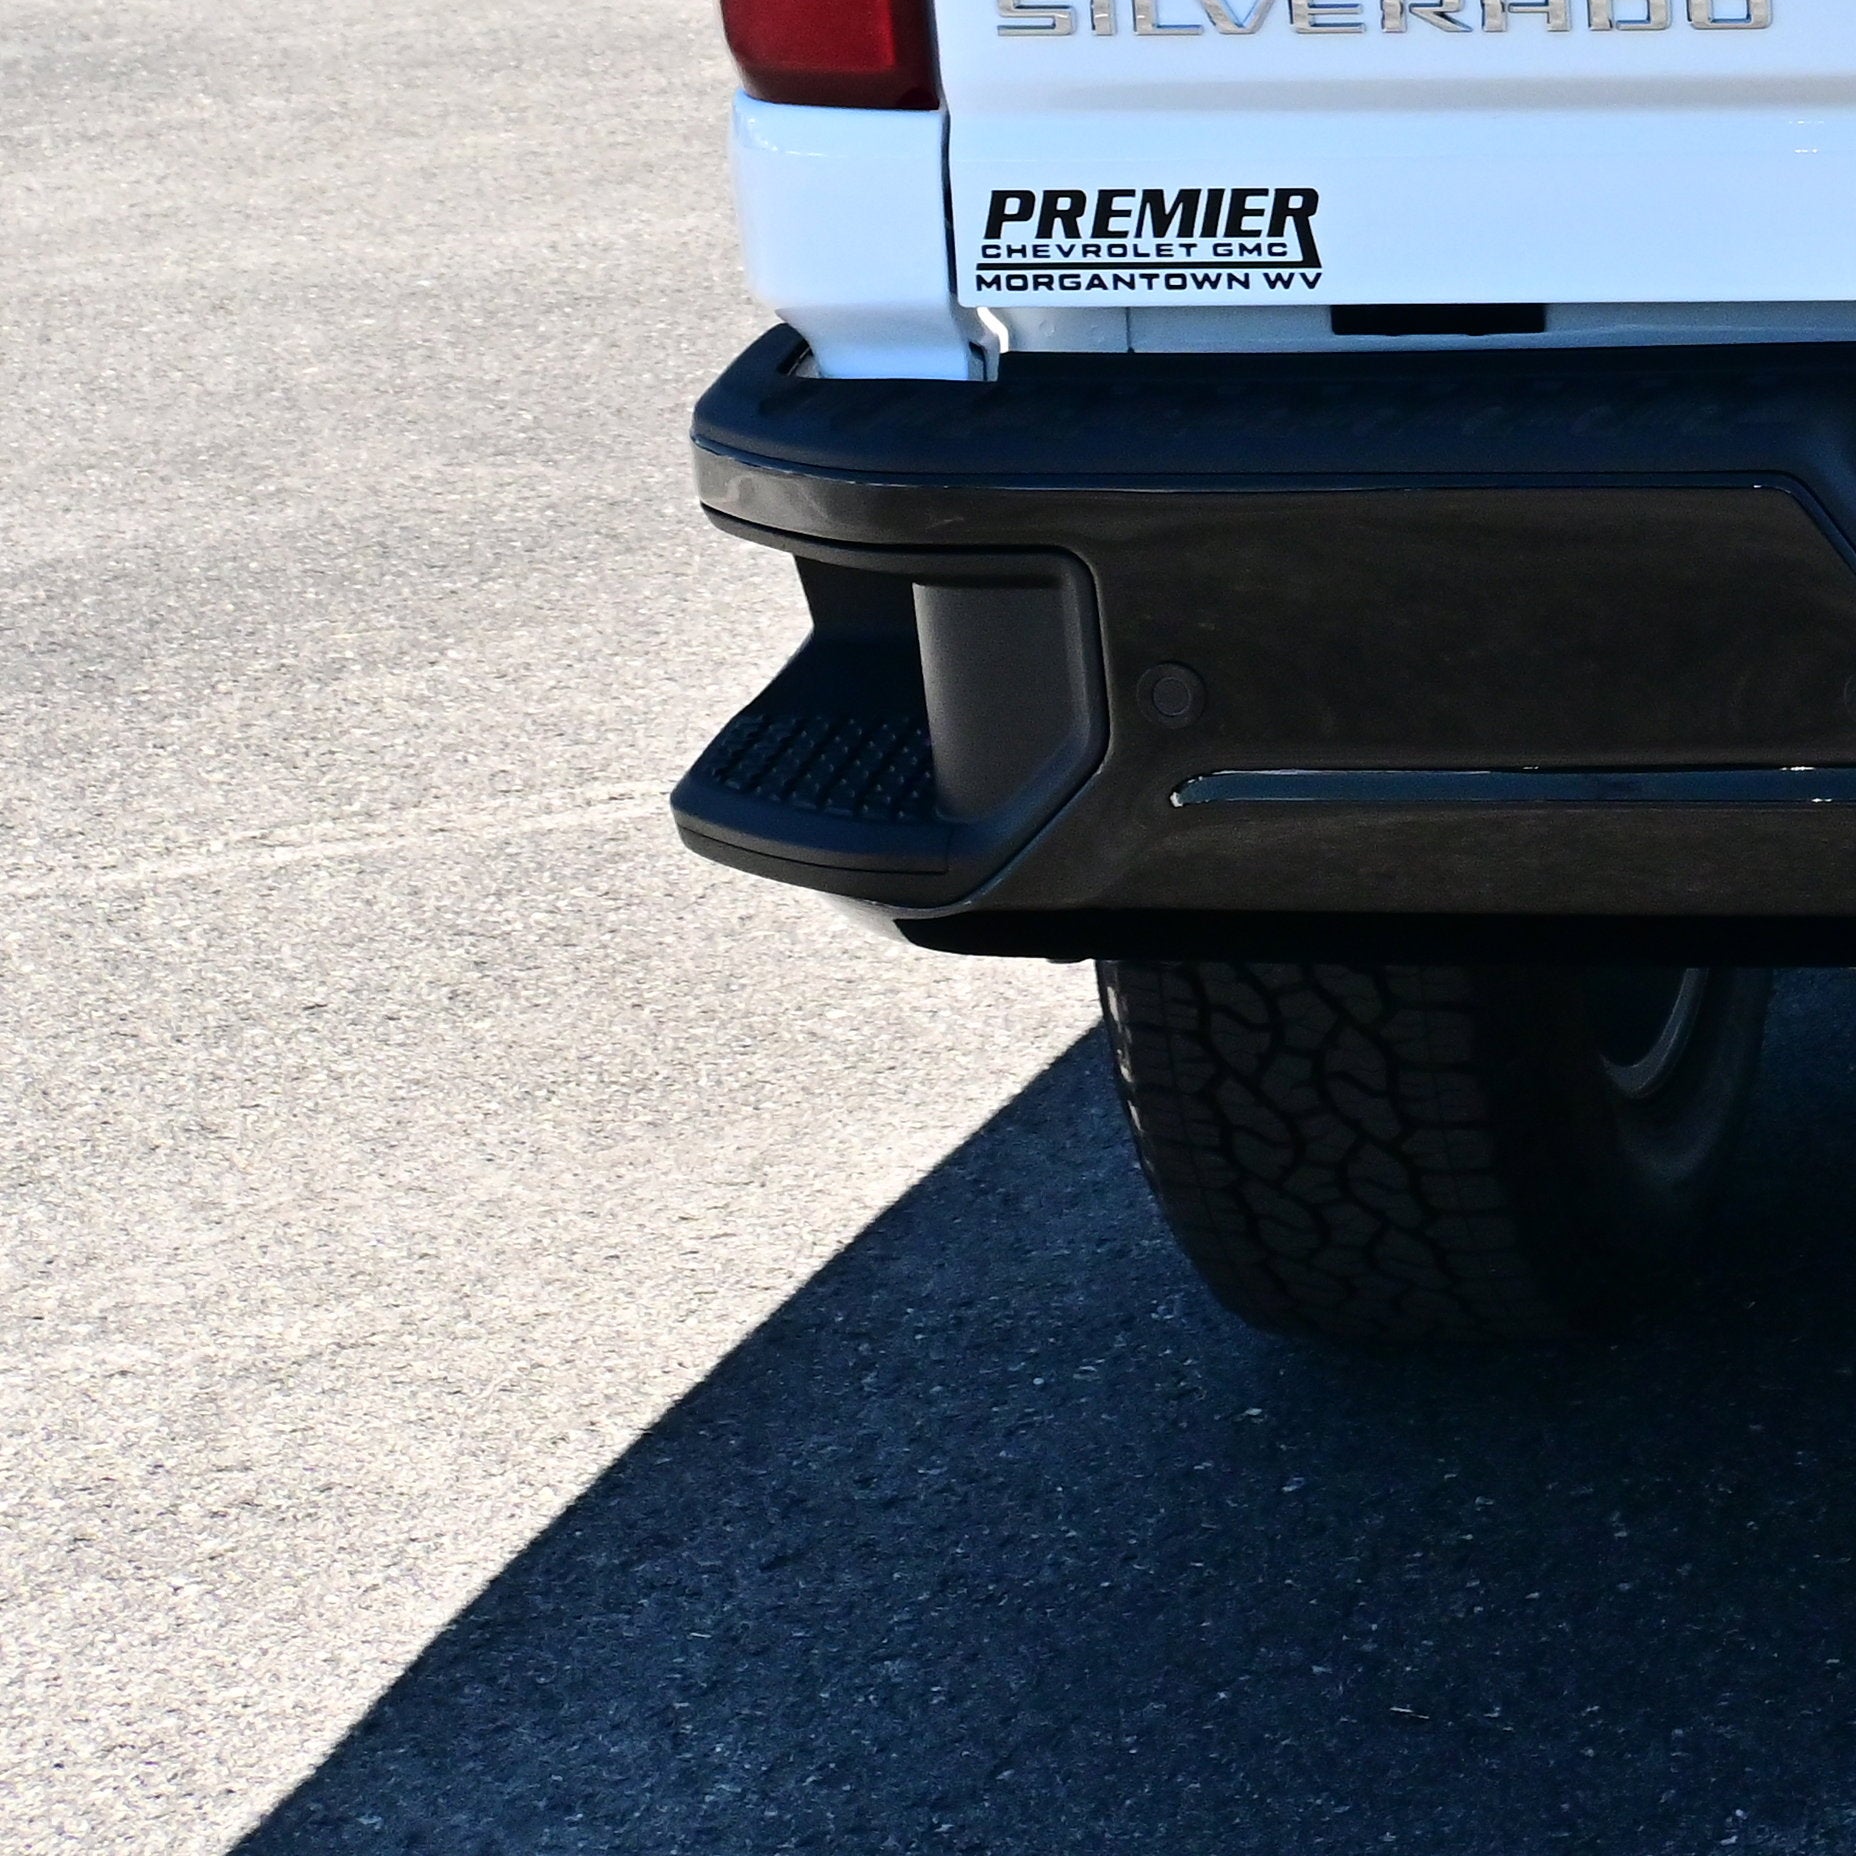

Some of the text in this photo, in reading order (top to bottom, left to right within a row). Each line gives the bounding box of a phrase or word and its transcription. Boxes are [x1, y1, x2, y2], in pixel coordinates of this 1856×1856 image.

[983, 187, 1322, 268] PREMIER
[981, 242, 1289, 259] CHEVROLET GMC
[975, 272, 1323, 292] MORGANTOWN WV
